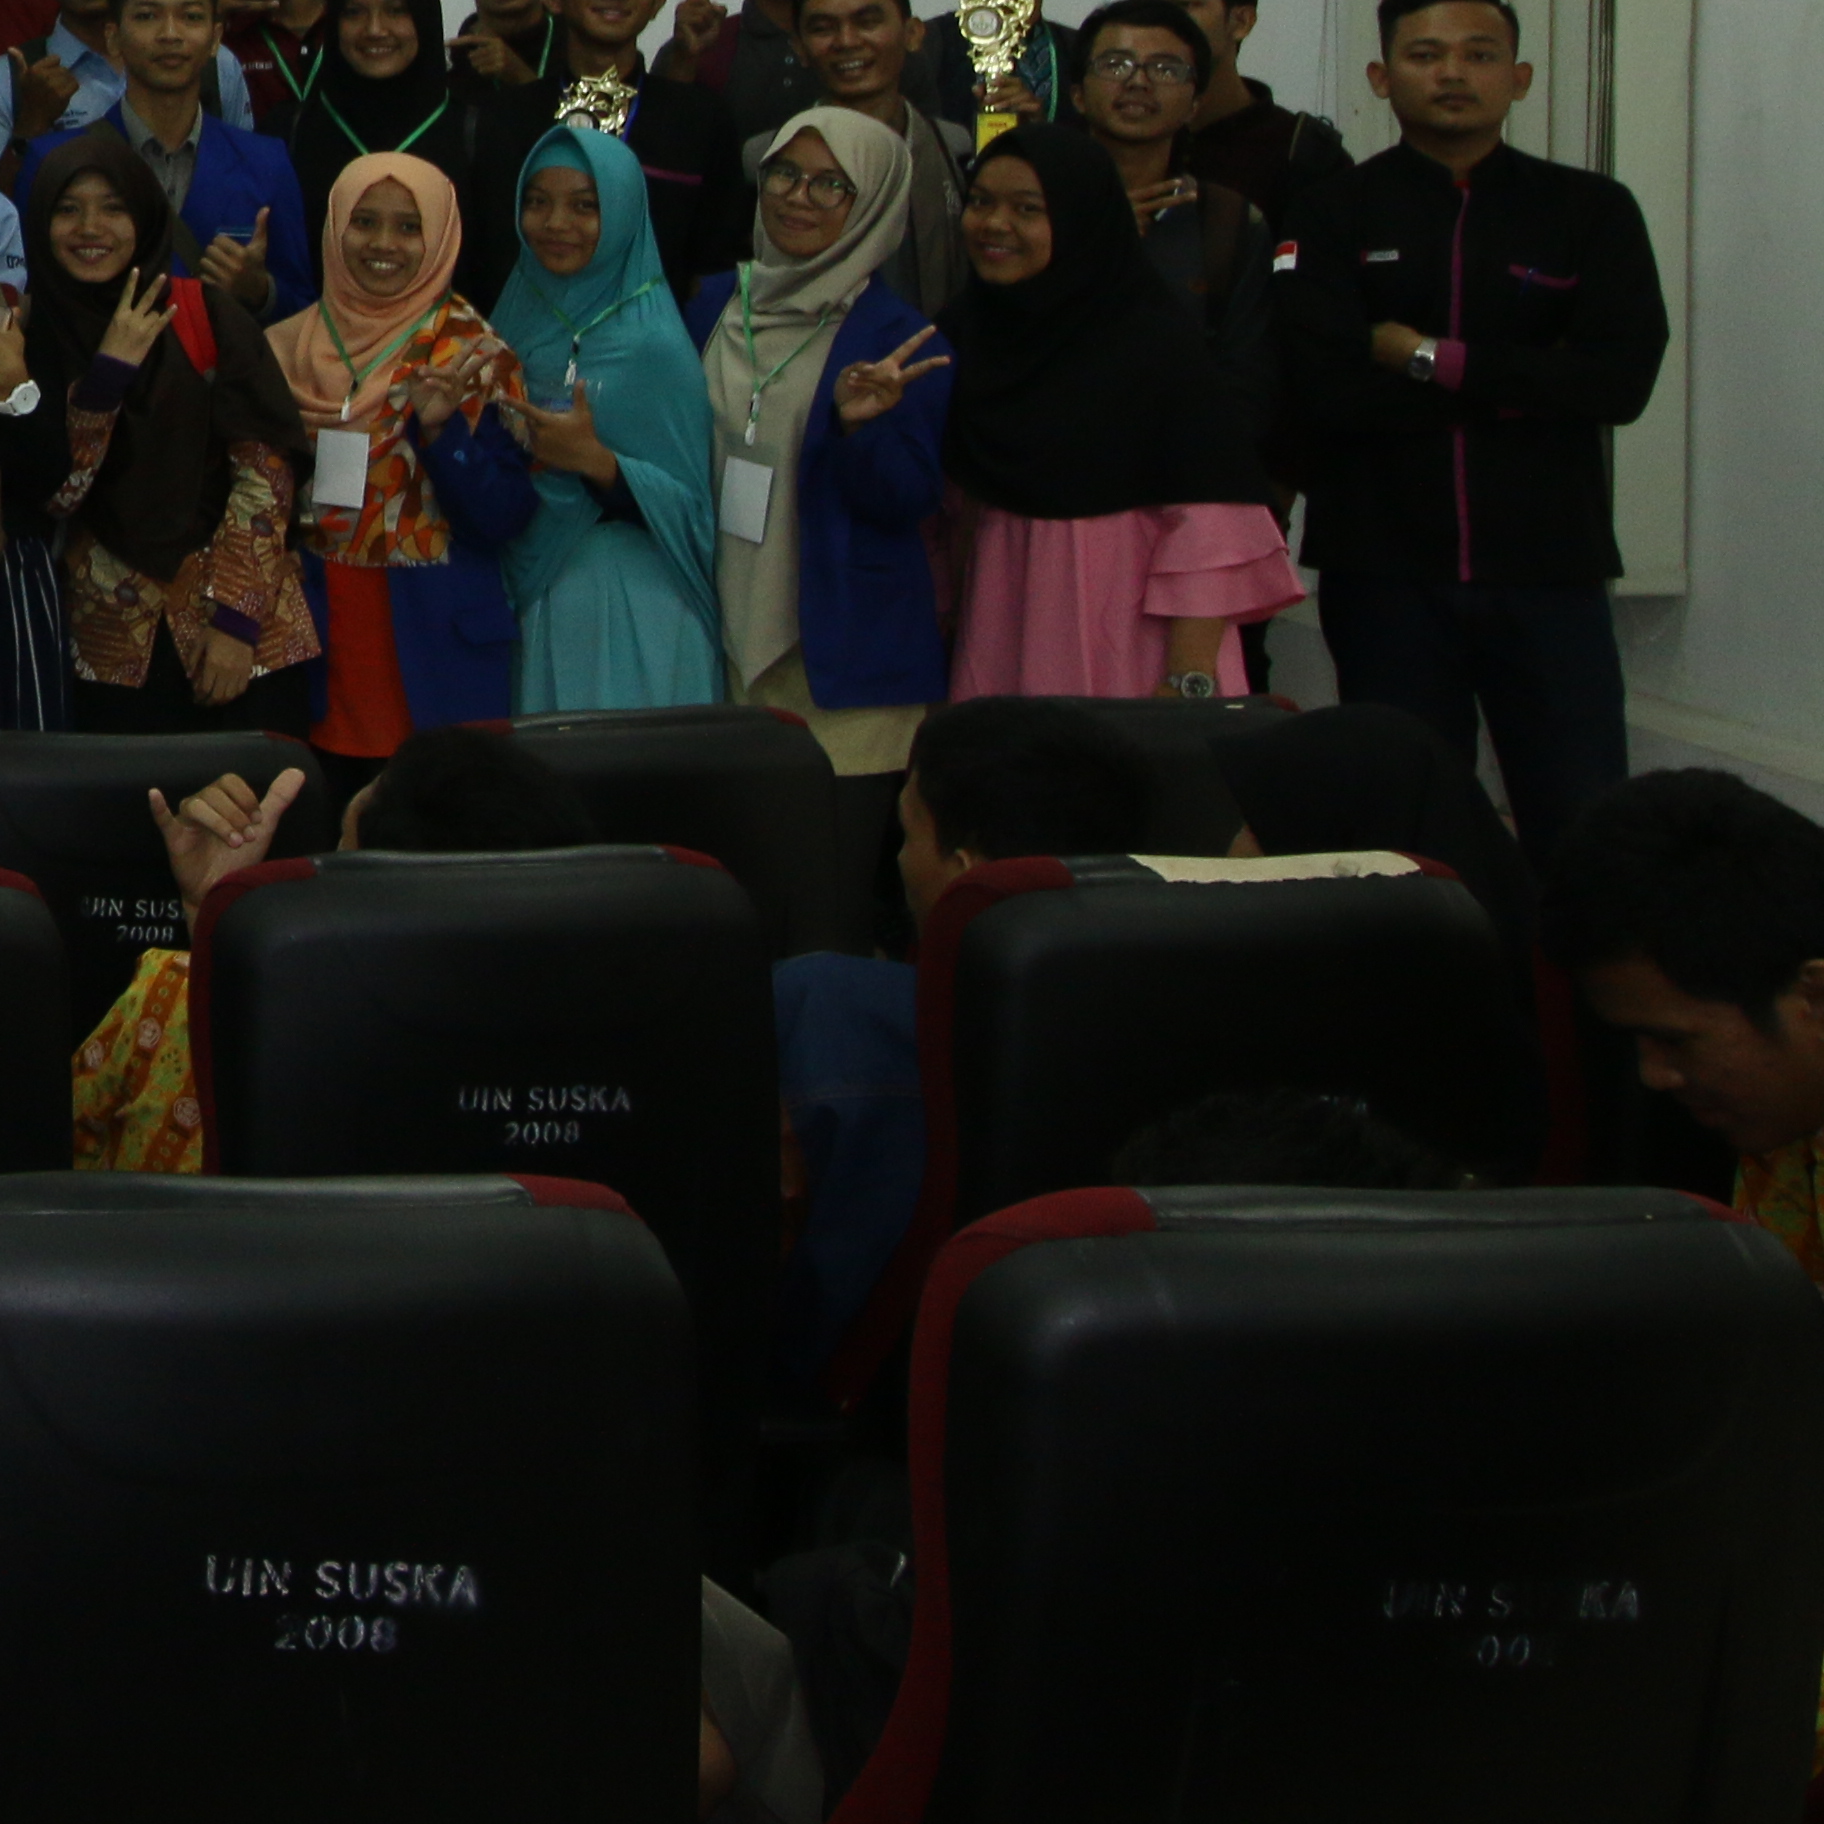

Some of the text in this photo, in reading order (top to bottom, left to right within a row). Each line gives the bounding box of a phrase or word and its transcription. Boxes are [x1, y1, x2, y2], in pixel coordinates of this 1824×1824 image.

[81, 895, 184, 921] UIN SUS
[115, 923, 176, 944] 2008
[457, 1084, 631, 1117] UIN SUSKA
[503, 1119, 582, 1147] 2008
[205, 1553, 480, 1609] UIN SUSKA
[273, 1612, 400, 1655] 2008
